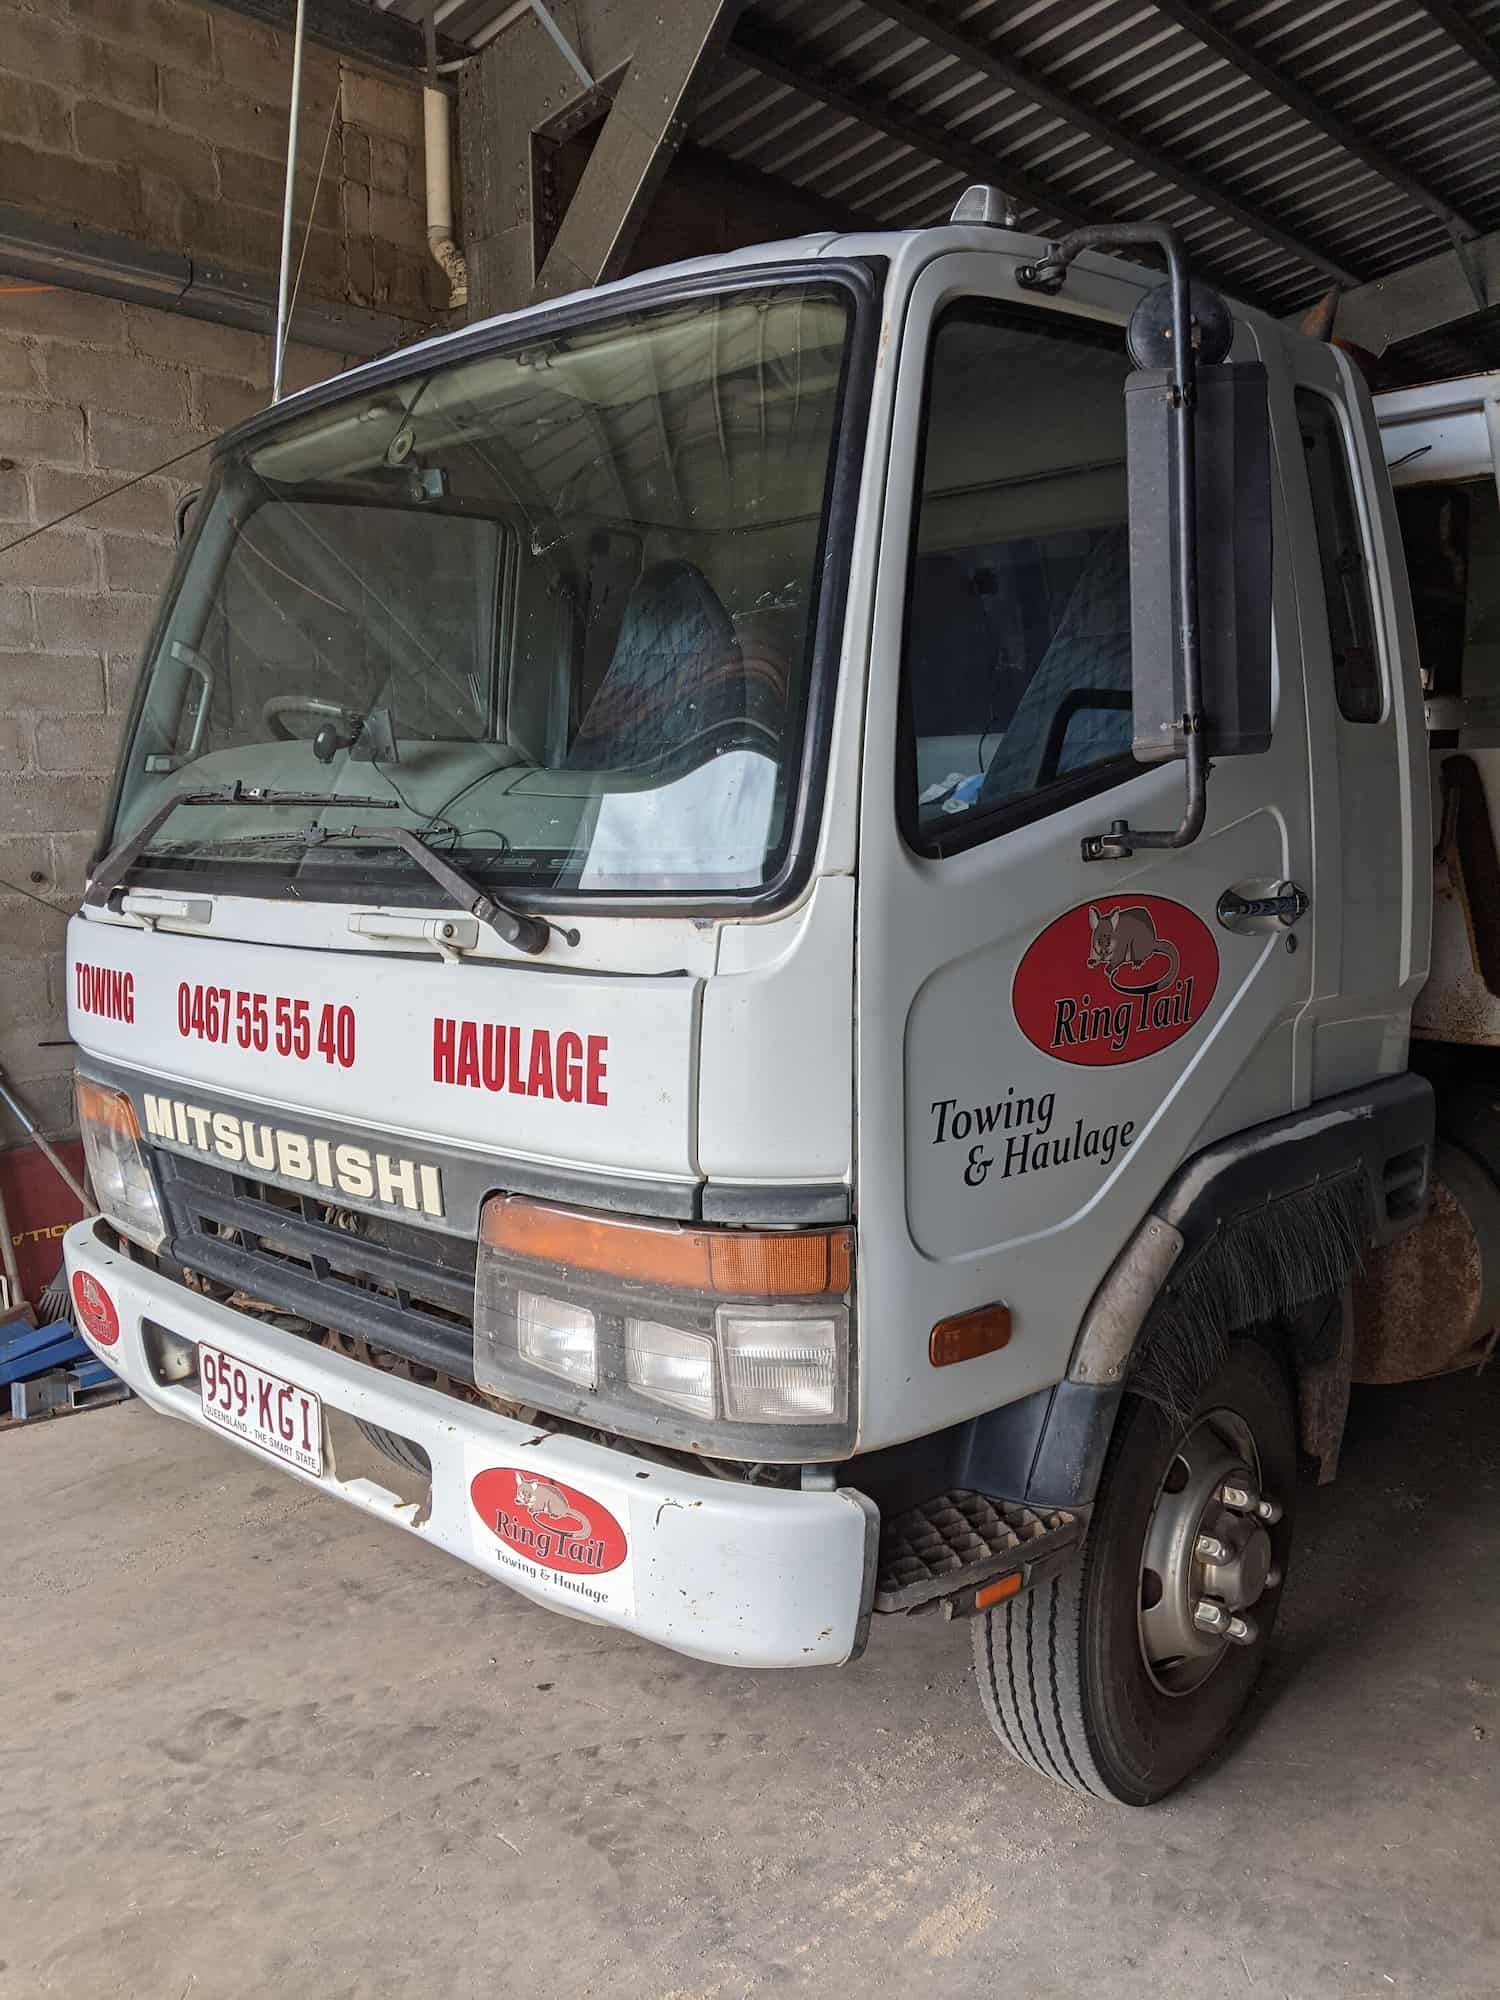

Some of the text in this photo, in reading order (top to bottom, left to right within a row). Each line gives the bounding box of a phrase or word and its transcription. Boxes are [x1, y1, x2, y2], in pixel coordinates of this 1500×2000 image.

[75, 961, 135, 1025] TOWING
[178, 981, 356, 1068] 0467 55 55 40
[433, 1017, 609, 1107] HAULAGE
[930, 1087, 1056, 1144] Towing
[143, 1093, 445, 1217] MITSUBISHI
[963, 1119, 1135, 1187] & Haulage
[205, 1404, 248, 1433] QUEENSLAND
[254, 1429, 268, 1444] THE
[269, 1436, 293, 1457] SMART
[295, 1450, 316, 1469] STATE
[495, 1549, 609, 1603] Towing & Haulage
